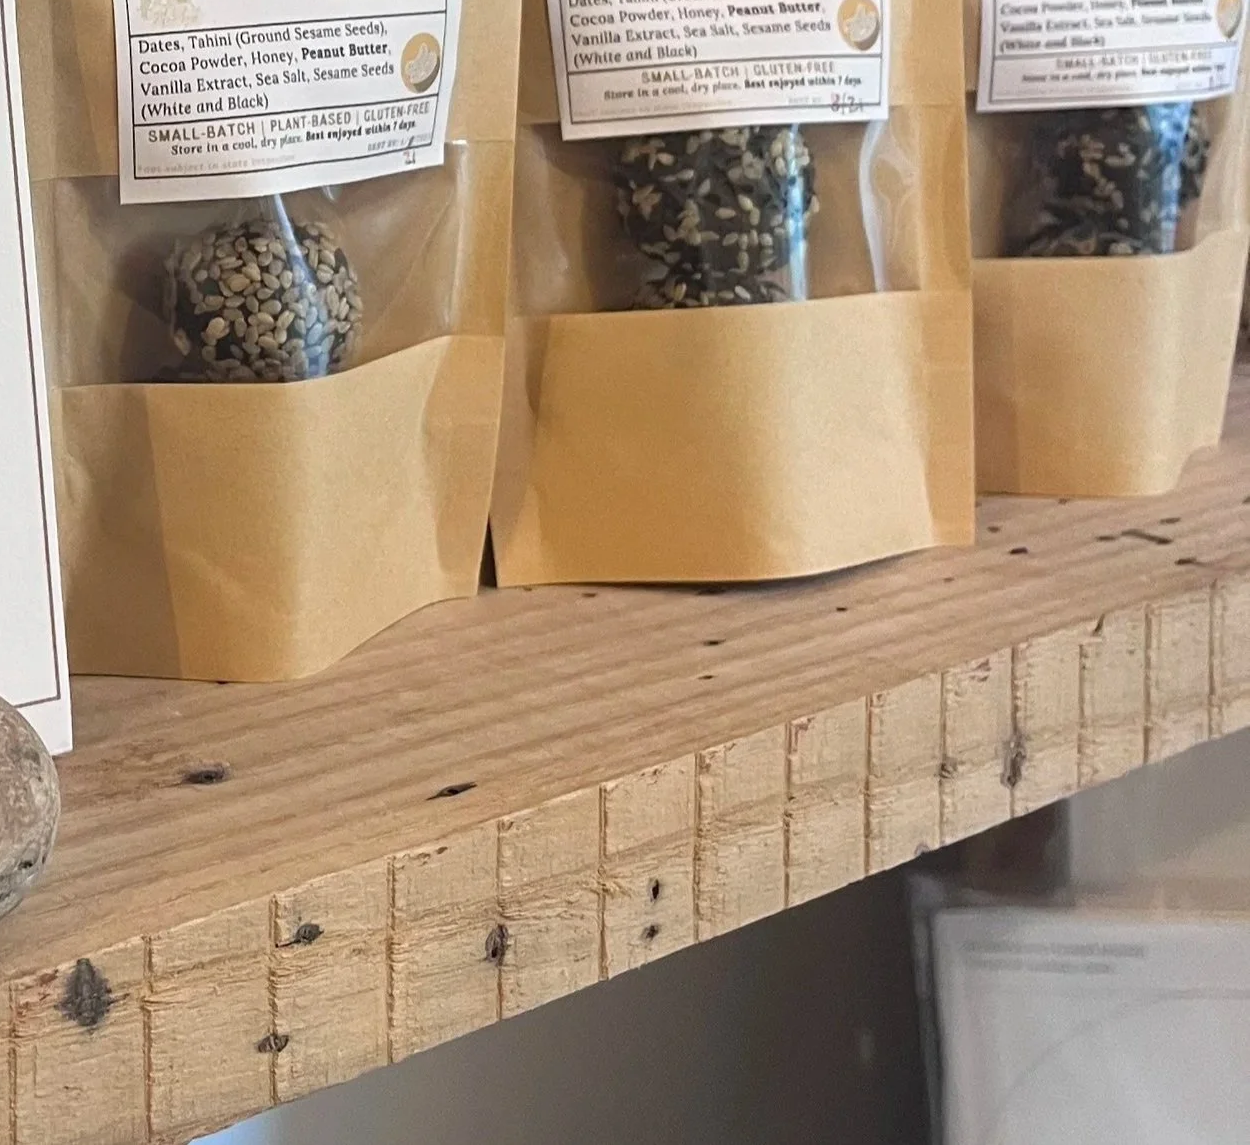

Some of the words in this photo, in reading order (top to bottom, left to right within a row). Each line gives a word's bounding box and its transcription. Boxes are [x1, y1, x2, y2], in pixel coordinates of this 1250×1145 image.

[138, 40, 184, 54] Dates,
[188, 33, 232, 49] Tahini
[236, 28, 291, 49] (Ground
[294, 27, 341, 40] Sesame
[140, 61, 186, 75] Cocoa
[191, 54, 247, 70] Powder,
[251, 51, 298, 65] Honey,
[301, 46, 345, 60] Peanut
[574, 52, 621, 69] (White
[626, 47, 652, 62] and
[657, 44, 697, 59] Black)
[141, 80, 192, 96] Vanilla
[197, 76, 252, 93] Extract,
[255, 73, 279, 86] Sea
[283, 69, 310, 84] Salt,
[314, 67, 357, 81] Sesame
[361, 61, 394, 77] Seeds
[141, 102, 191, 122] (White
[197, 97, 223, 114] and
[228, 92, 268, 110] Black)
[148, 120, 256, 143] SMALL-BATCH
[270, 111, 352, 132] PLANT-BASED
[364, 101, 430, 122] GLUTEN-FREE
[171, 144, 203, 156] Store
[207, 142, 219, 153] in
[306, 129, 325, 141] Best
